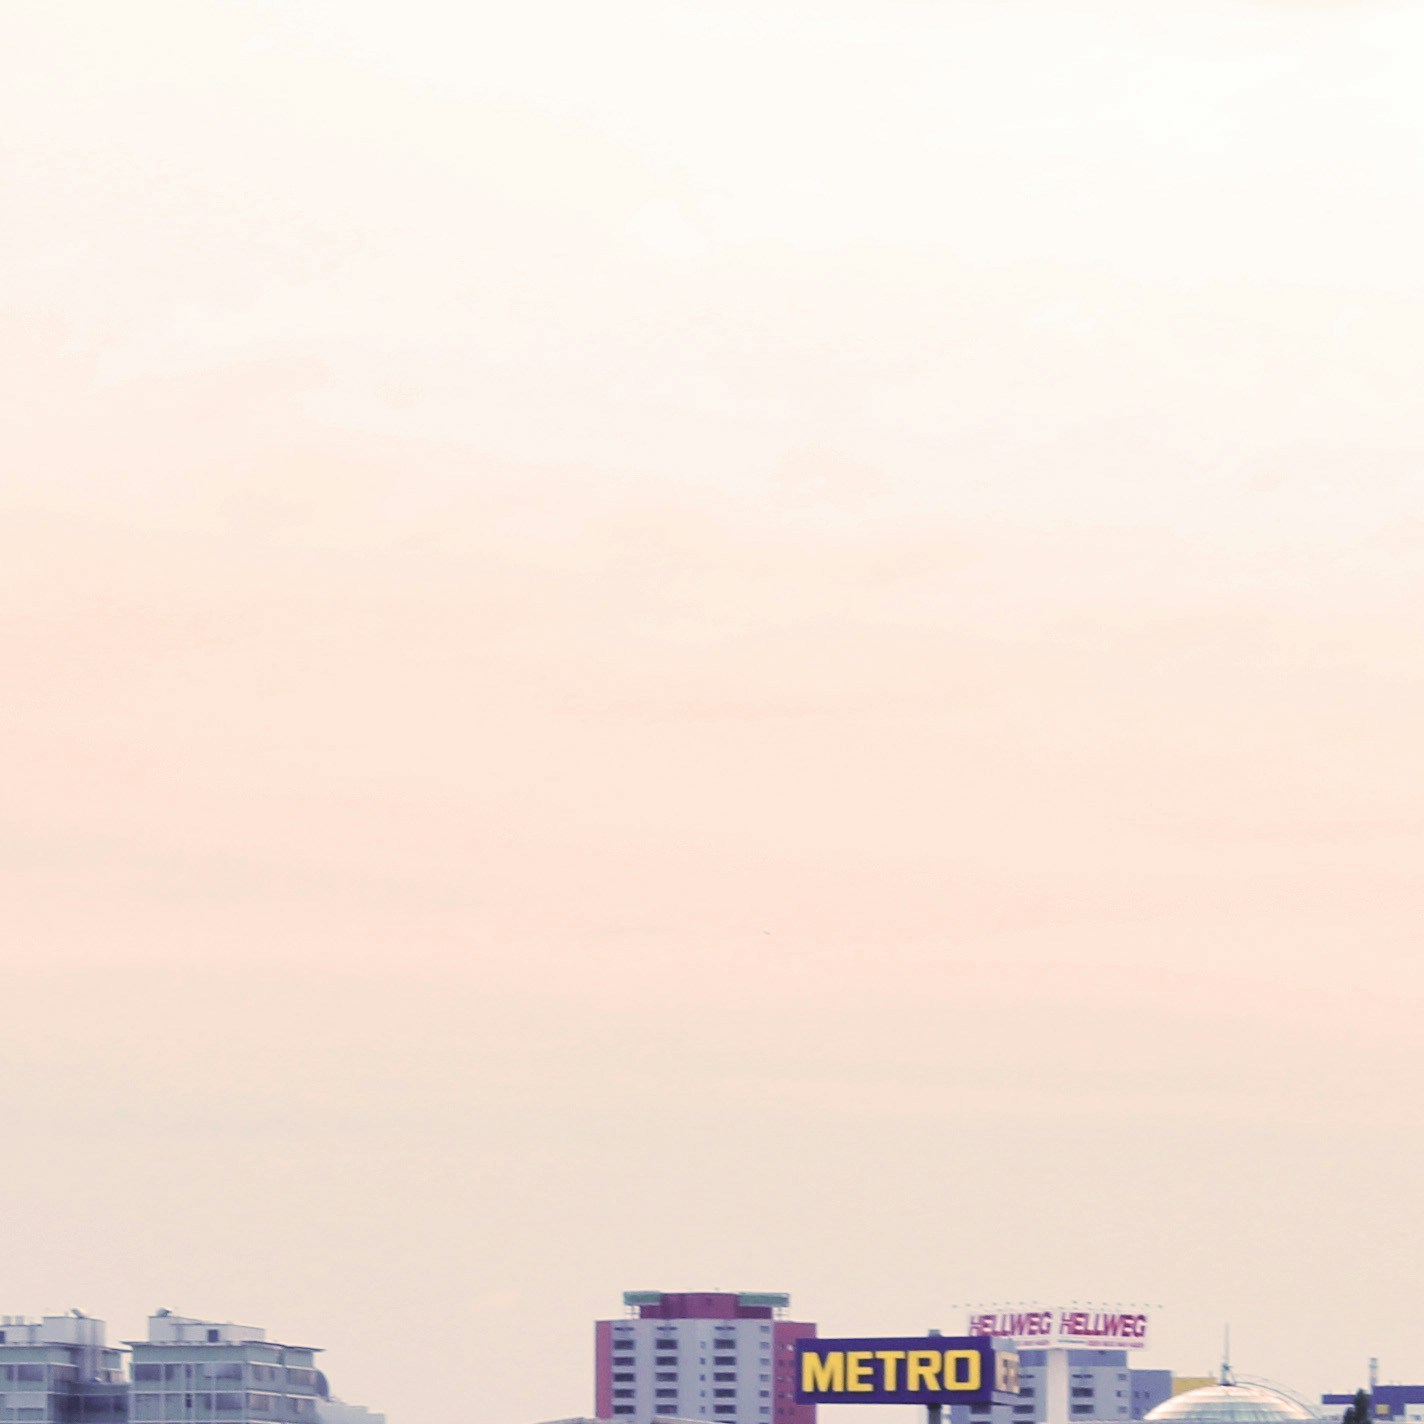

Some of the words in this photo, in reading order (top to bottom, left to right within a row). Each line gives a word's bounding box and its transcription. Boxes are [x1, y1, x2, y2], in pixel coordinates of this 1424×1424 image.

[969, 1312, 1051, 1337] HELLWEG
[1060, 1312, 1146, 1338] HELLWEG
[802, 1350, 982, 1392] METRO
